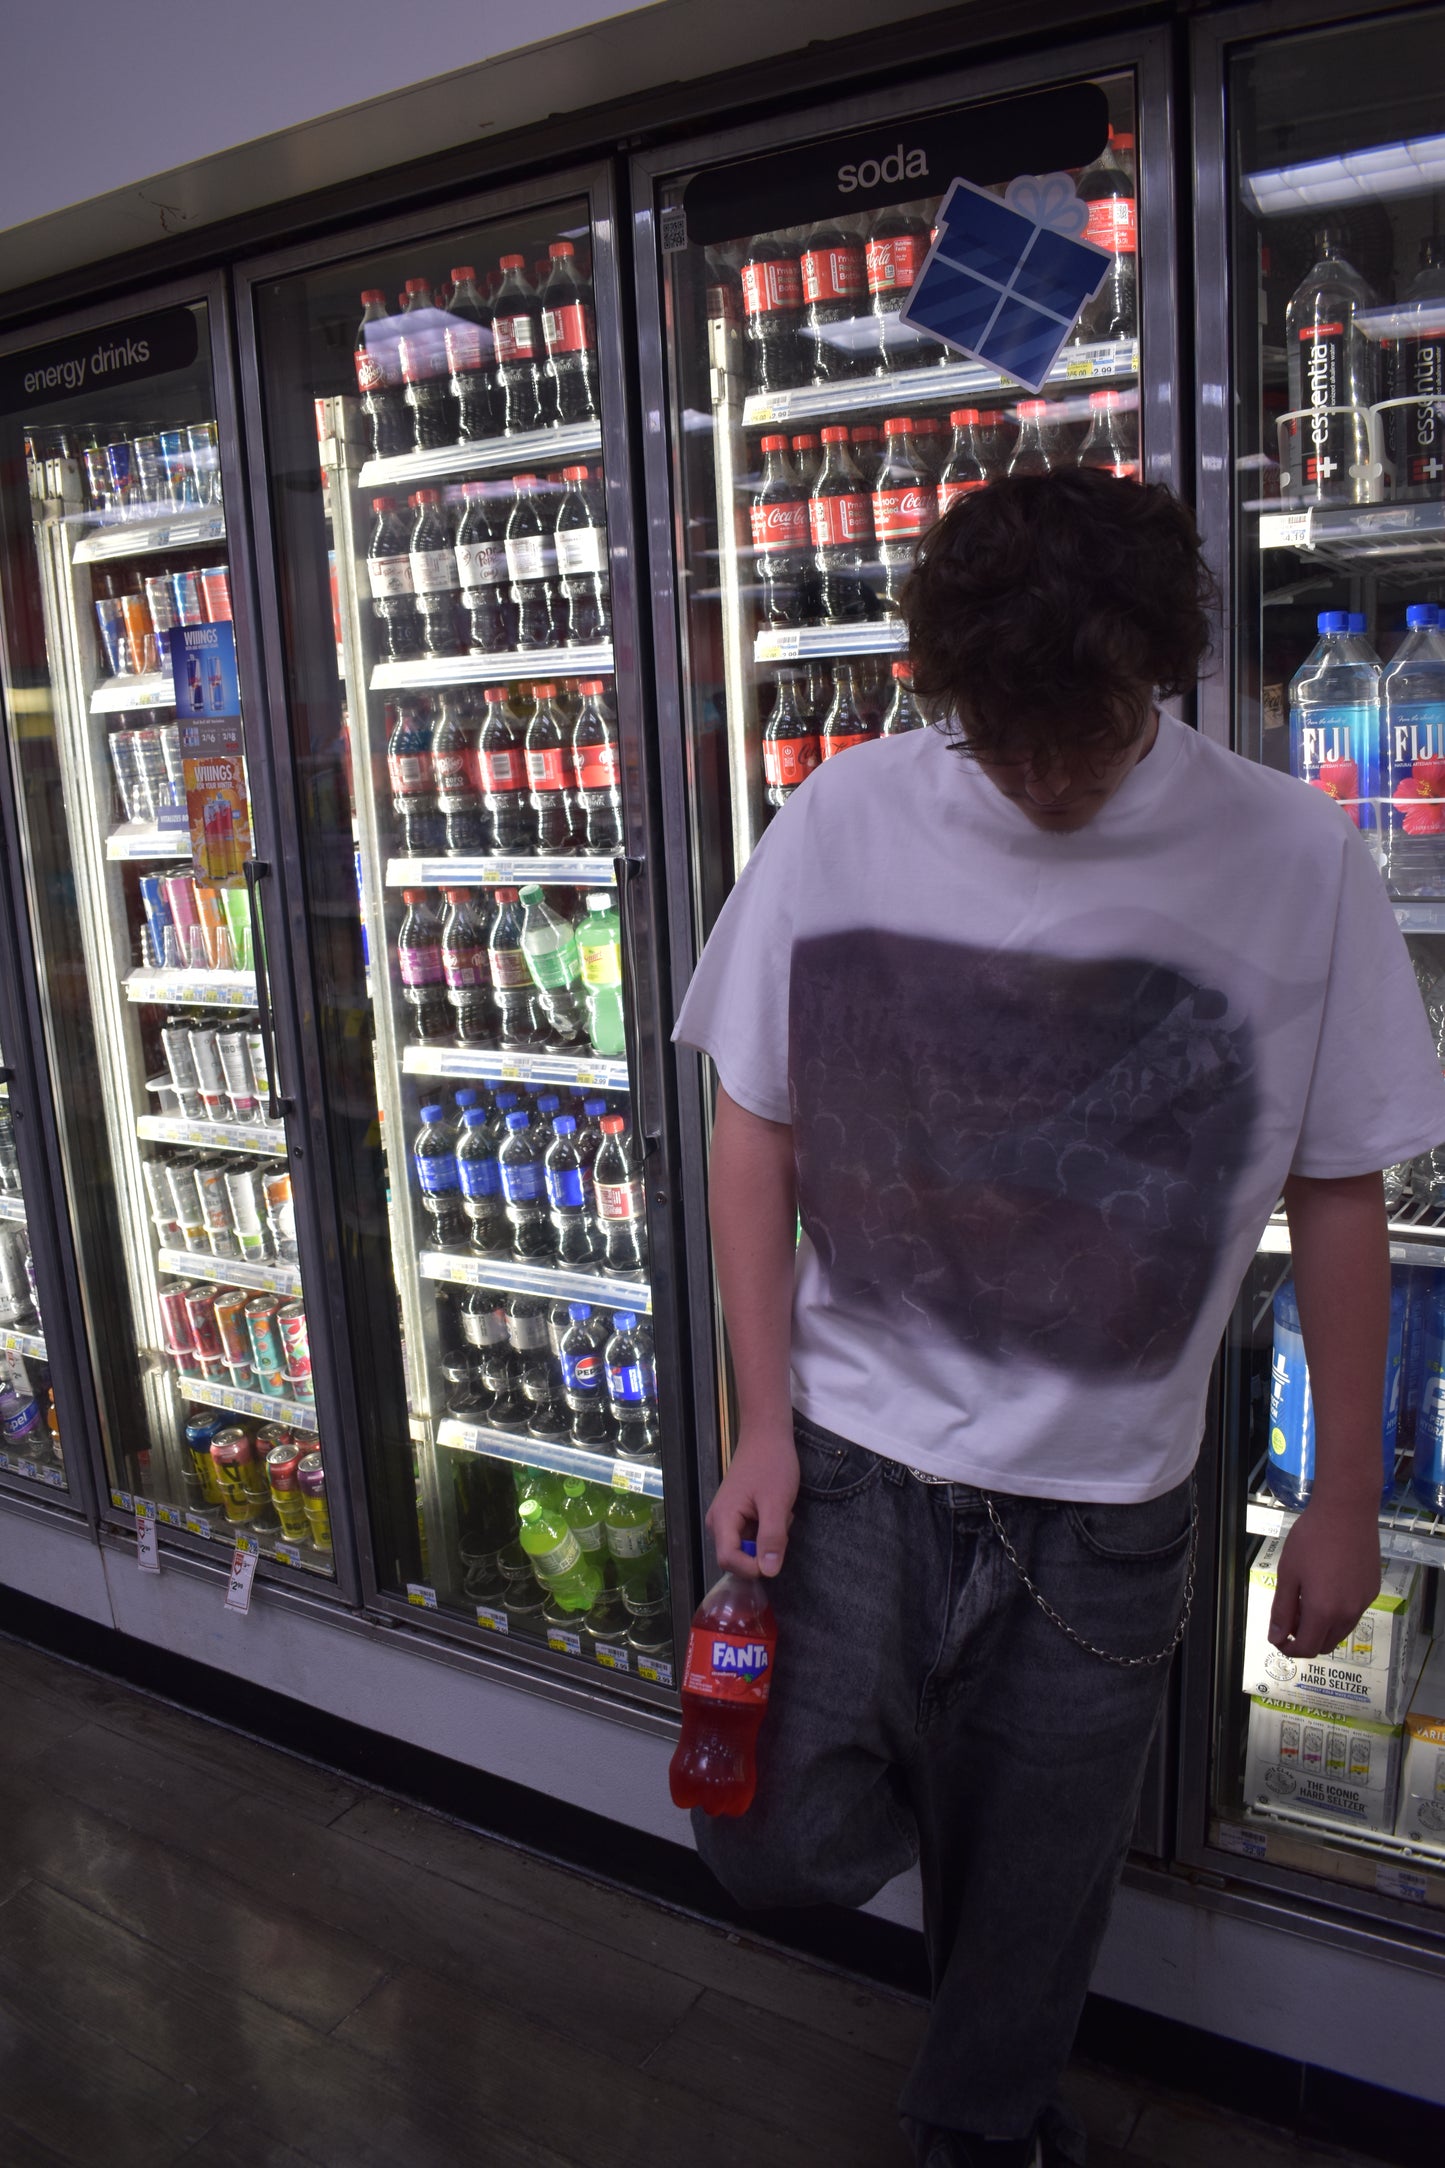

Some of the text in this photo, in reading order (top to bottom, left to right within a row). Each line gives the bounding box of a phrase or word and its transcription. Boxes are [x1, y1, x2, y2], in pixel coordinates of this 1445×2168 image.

[837, 144, 929, 193] soda
[24, 338, 150, 393] energy drinks
[1308, 343, 1329, 445] essentia
[1414, 346, 1435, 445] essentia
[1302, 726, 1351, 765] FIJI
[1393, 724, 1444, 762] FIJI
[713, 1642, 768, 1669] FANTA
[1300, 1673, 1369, 1696] HARD SELTZER
[1308, 1663, 1362, 1684] THE ICONIC
[1260, 1697, 1306, 1713] VARIETY
[1307, 1707, 1334, 1720] PACK
[1416, 1728, 1445, 1741] VARIE
[1299, 1787, 1325, 1801] HARD
[1327, 1793, 1365, 1813] SELTZER
[1306, 1779, 1360, 1801] THE ICONIC
